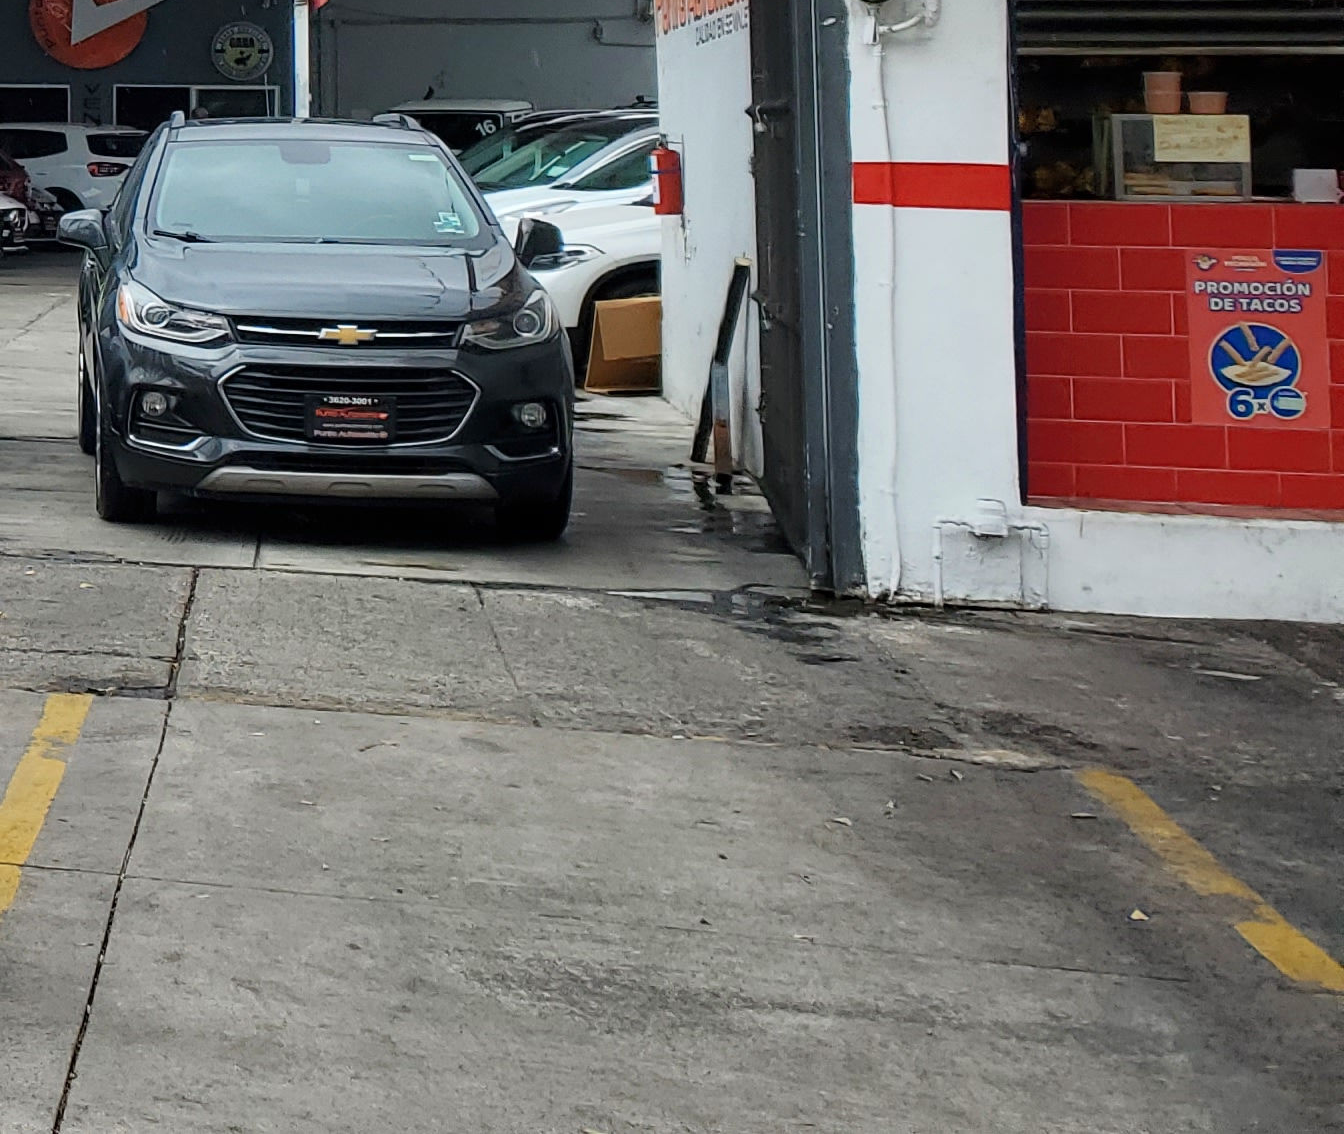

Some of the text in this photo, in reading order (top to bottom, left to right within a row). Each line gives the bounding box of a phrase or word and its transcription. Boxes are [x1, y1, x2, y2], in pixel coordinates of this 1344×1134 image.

[475, 119, 497, 136] 16
[1193, 279, 1312, 297] PROMOCIÓN
[1209, 297, 1303, 313] DE TACOS
[1228, 387, 1255, 419] 6
